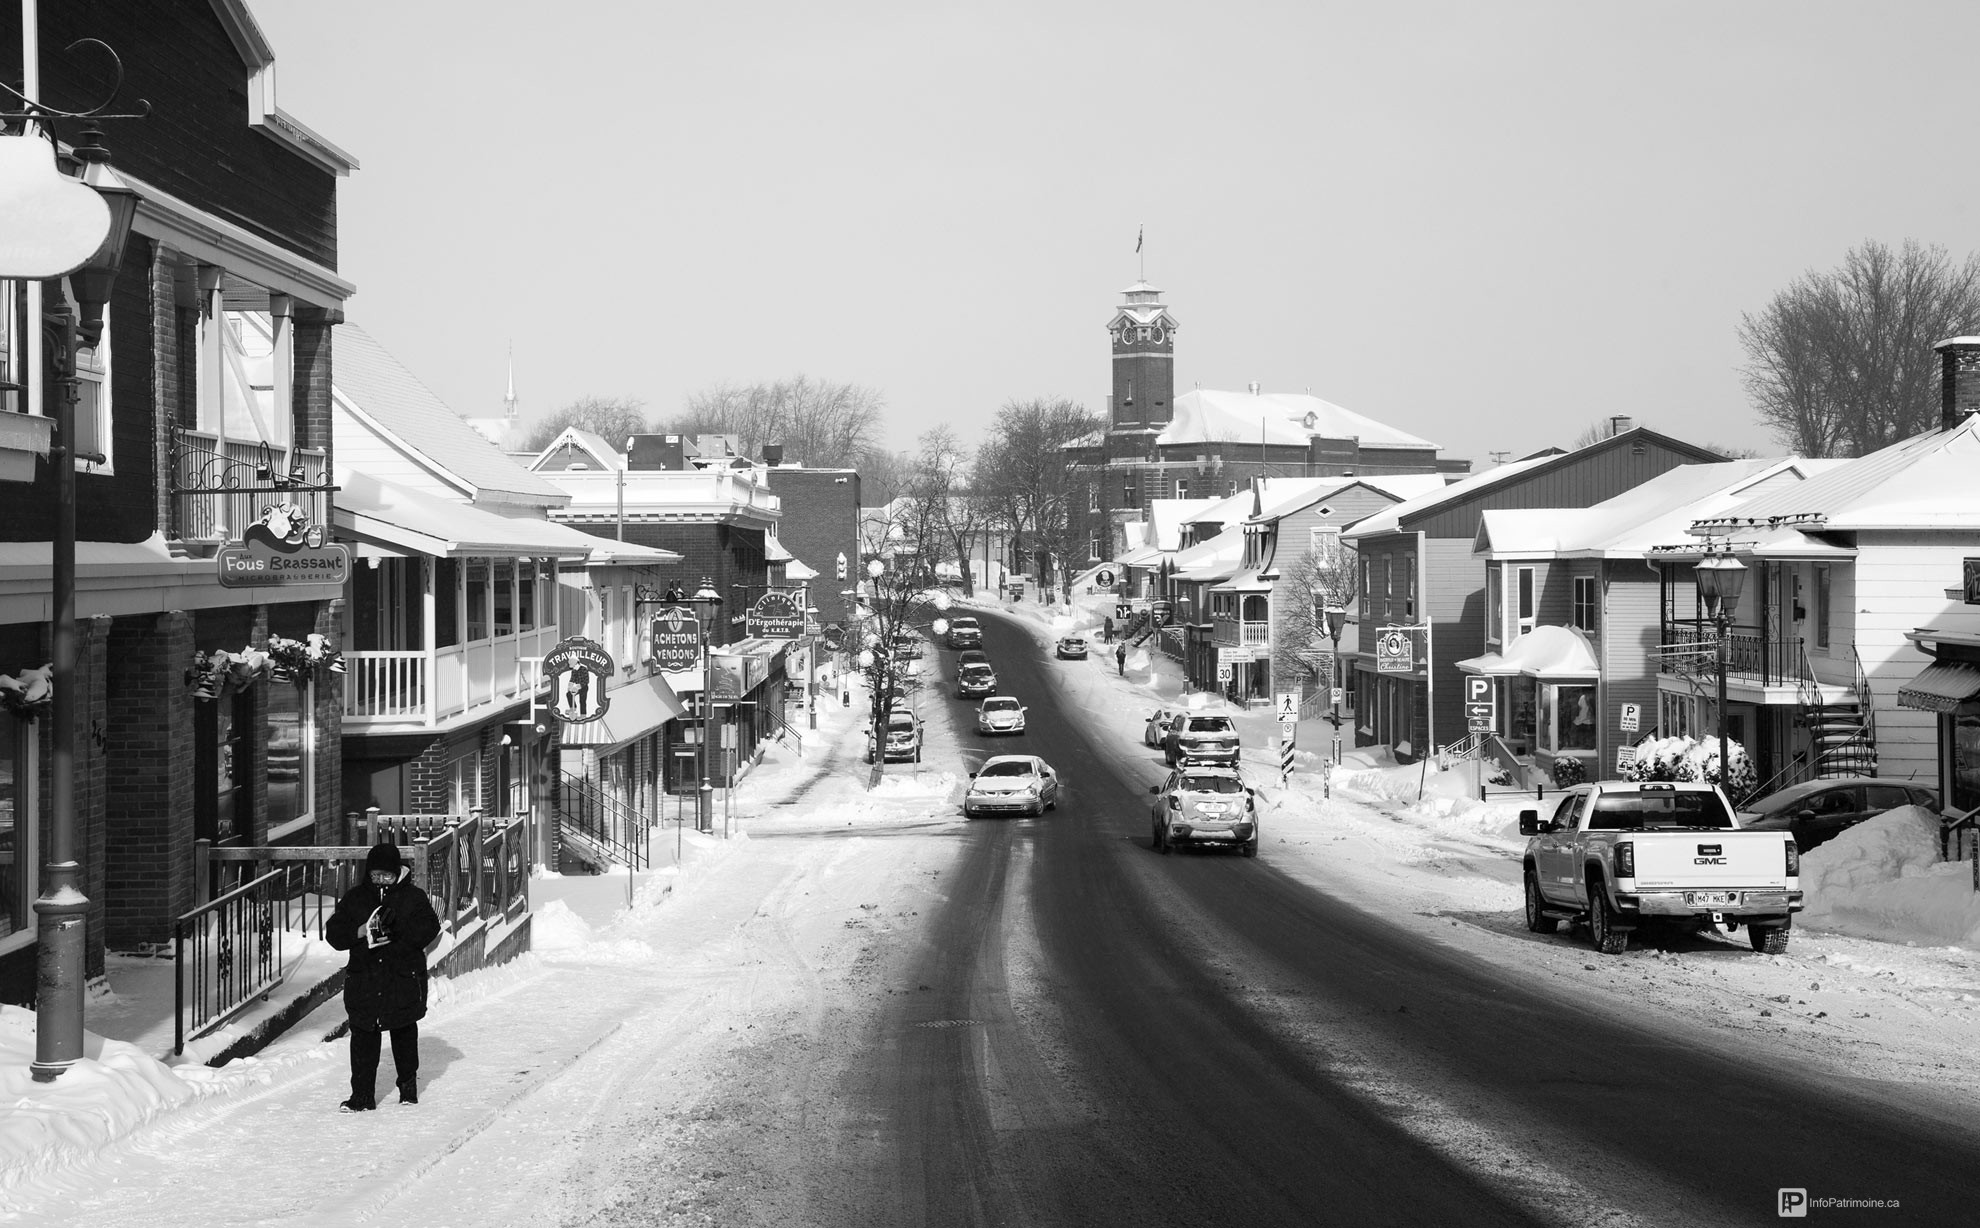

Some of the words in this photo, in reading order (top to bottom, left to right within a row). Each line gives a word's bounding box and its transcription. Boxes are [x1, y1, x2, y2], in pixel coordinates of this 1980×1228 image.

[226, 556, 265, 571] Fous
[269, 556, 343, 570] Brassant
[758, 594, 795, 610] Clinique
[748, 619, 804, 628] D'Ergothérapie
[654, 632, 698, 645] ACHETONS
[548, 650, 608, 667] TRAVAILLEUR
[656, 649, 695, 660] VENDONS
[1219, 668, 1231, 679] 30
[1472, 680, 1488, 700] P
[1627, 706, 1635, 716] P
[1694, 857, 1727, 865] GMC
